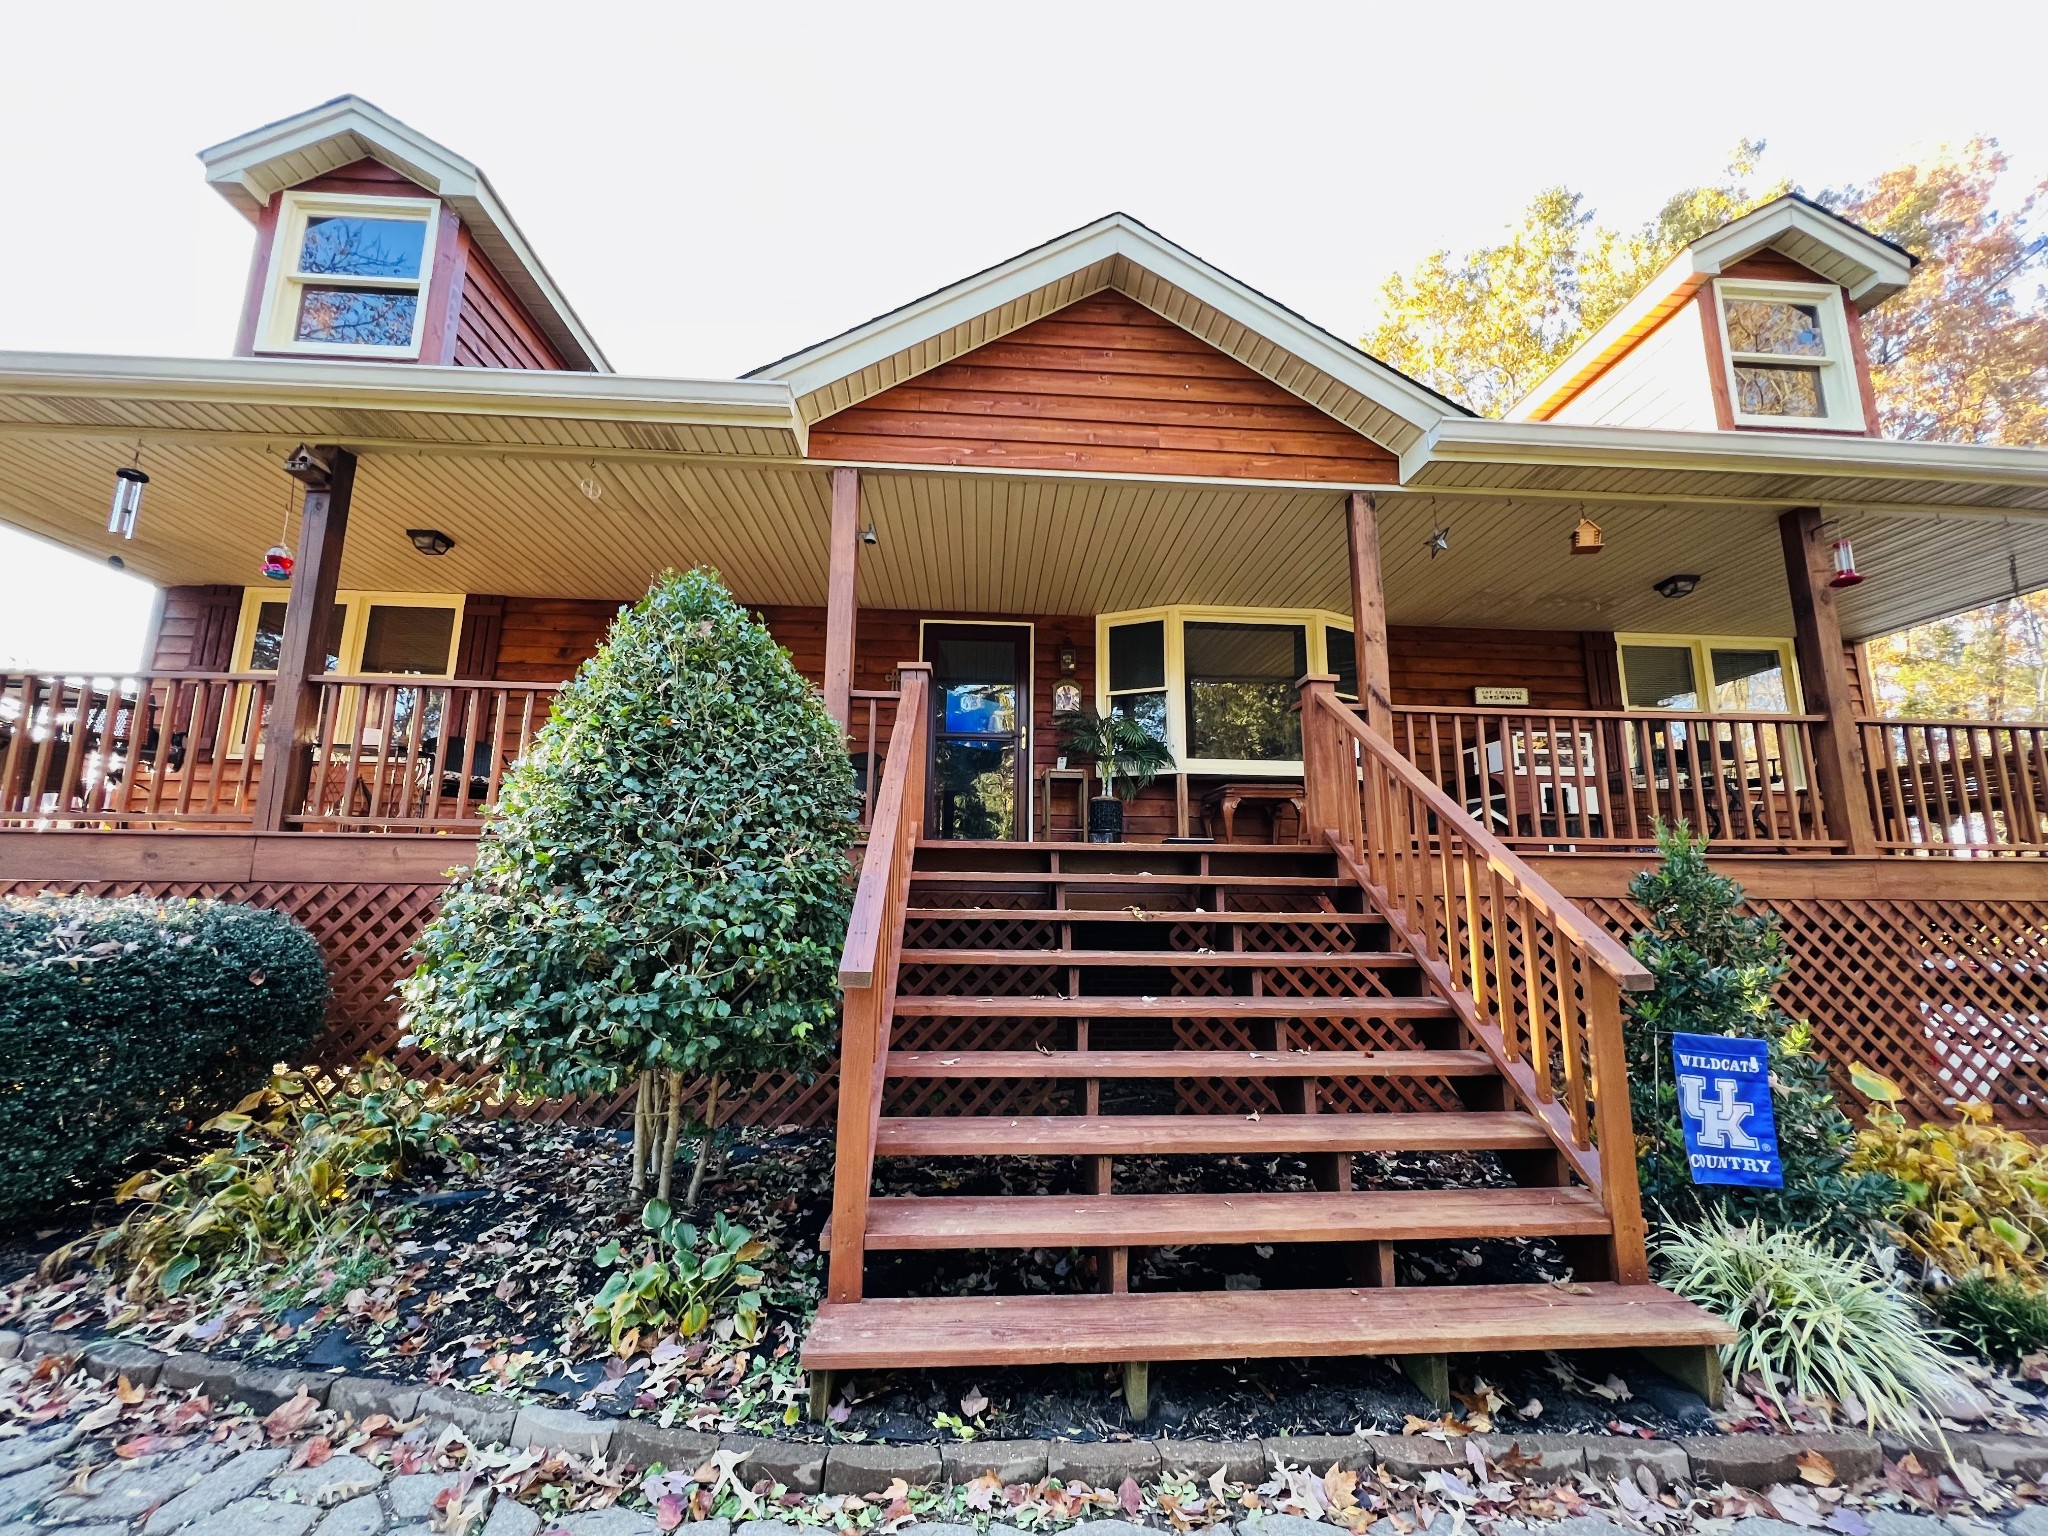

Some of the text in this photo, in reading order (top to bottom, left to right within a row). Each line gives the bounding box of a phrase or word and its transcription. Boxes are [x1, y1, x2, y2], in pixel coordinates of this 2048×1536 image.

[1679, 1054, 1760, 1073] WILDCATS
[1680, 1073, 1760, 1151] UK
[1690, 1153, 1771, 1173] COUNTRY
